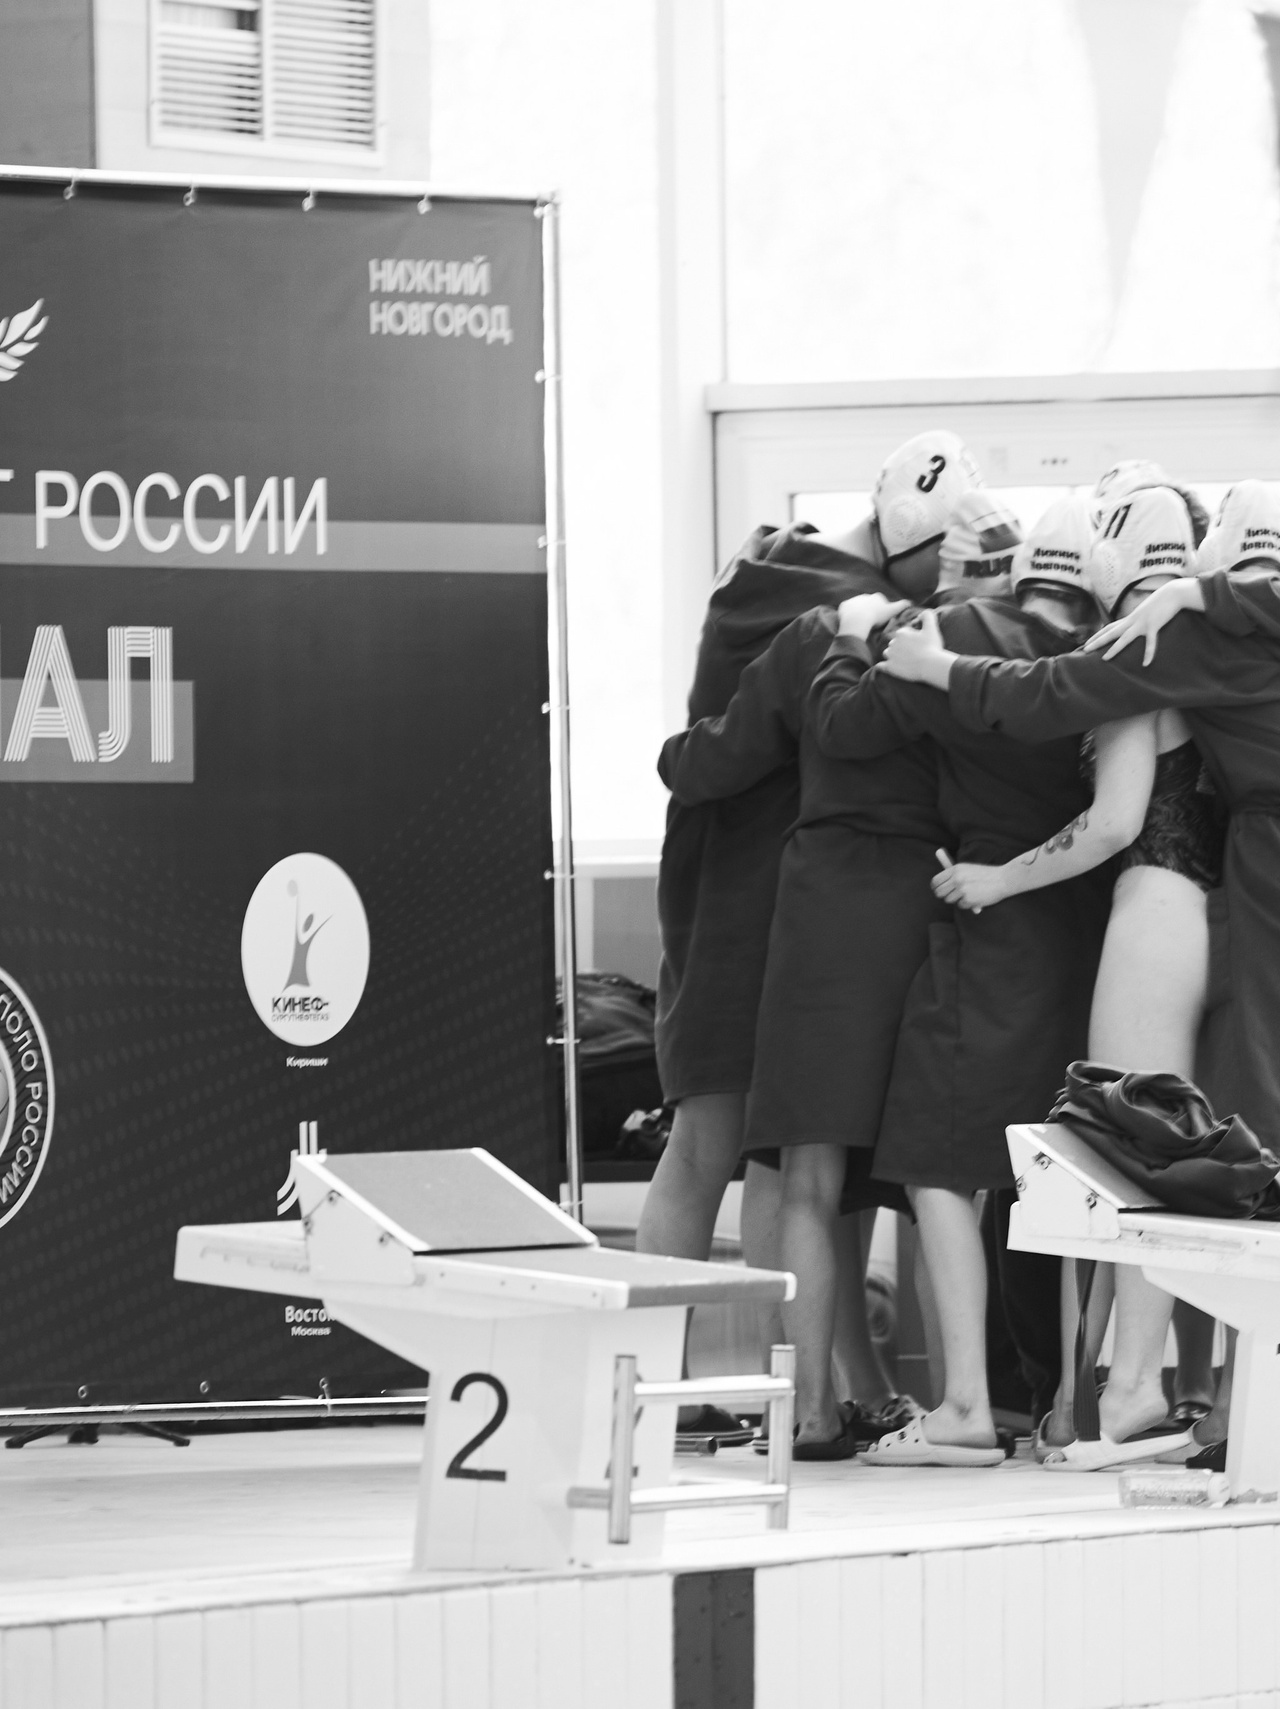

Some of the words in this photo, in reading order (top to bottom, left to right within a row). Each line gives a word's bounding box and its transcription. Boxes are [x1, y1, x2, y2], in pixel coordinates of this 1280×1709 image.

[368, 254, 491, 296] НИЖНИЙ
[369, 300, 514, 345] НОВГОРОД
[916, 454, 946, 493] 3
[35, 469, 328, 556] РОССИИ
[286, 1056, 329, 1069] Кириши
[285, 1305, 333, 1323] Восто
[291, 1326, 332, 1337] Москва
[446, 1372, 509, 1482] 2
